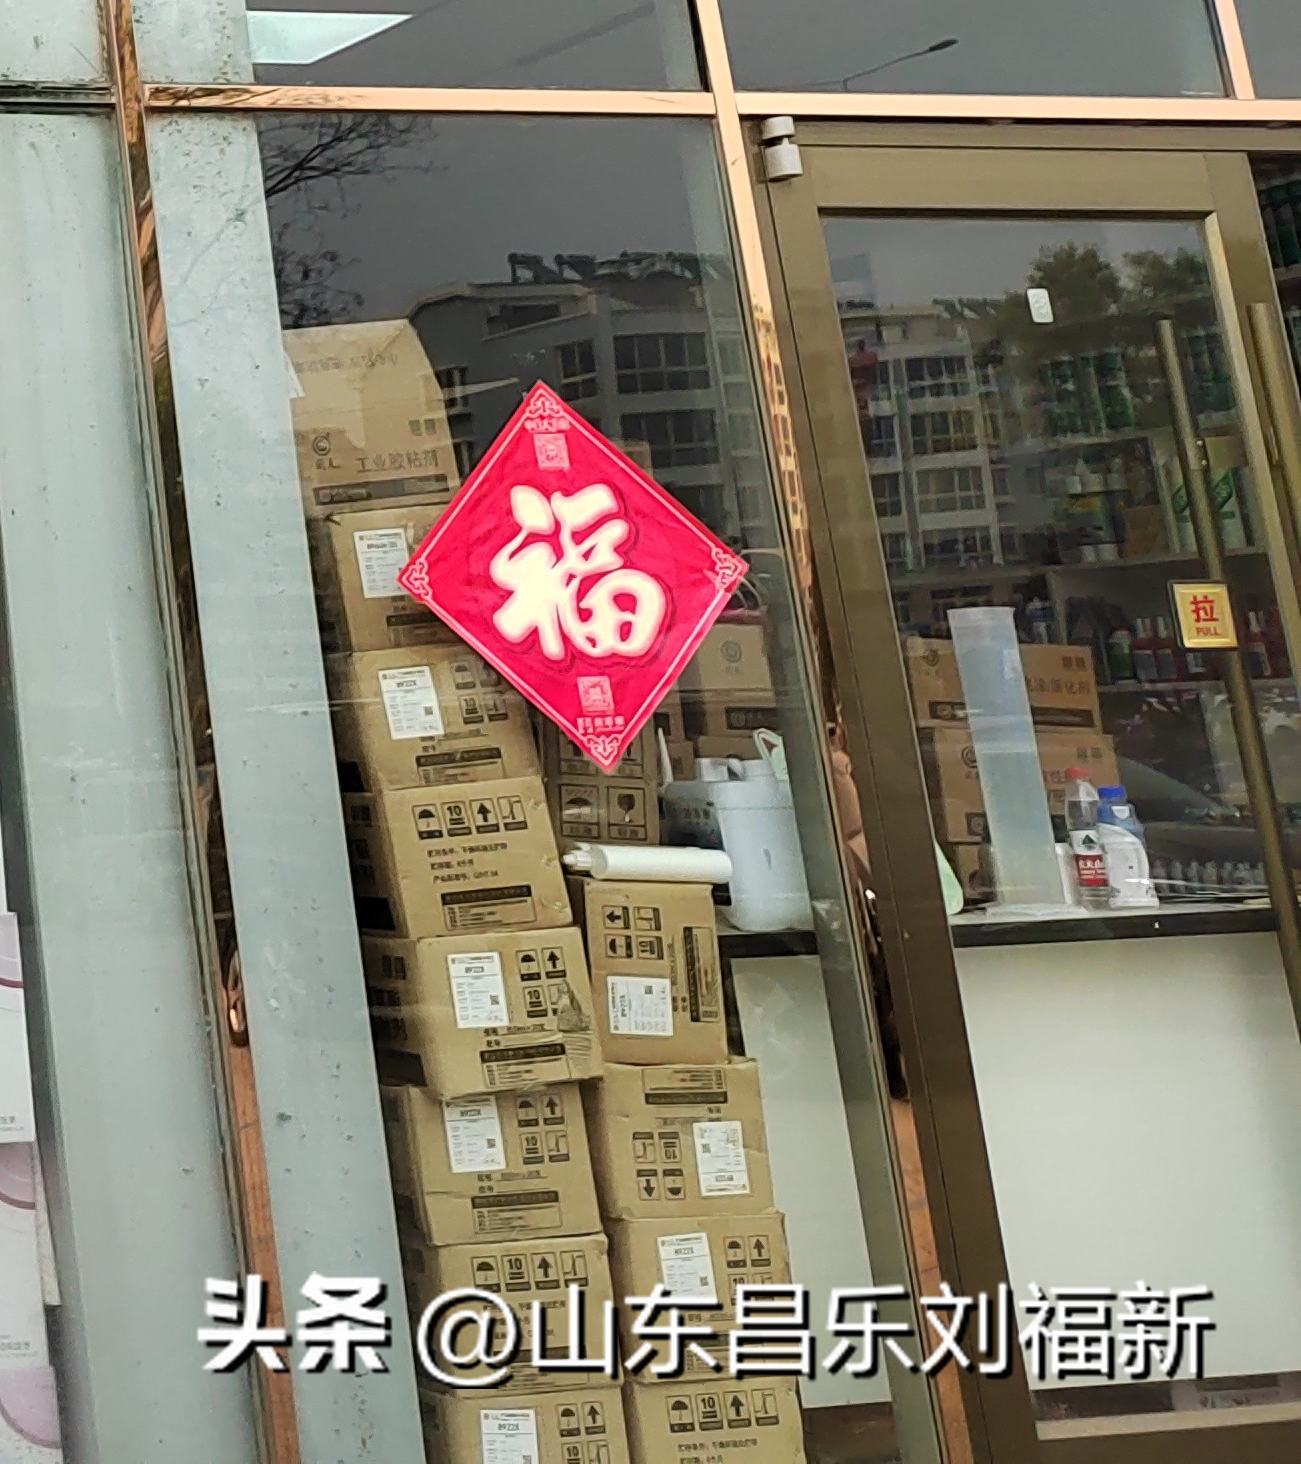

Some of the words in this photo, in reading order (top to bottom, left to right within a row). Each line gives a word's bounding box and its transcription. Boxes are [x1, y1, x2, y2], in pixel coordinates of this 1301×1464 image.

[489, 483, 668, 662] 福
[1189, 594, 1220, 623] 拉
[1195, 626, 1222, 637] PULL
